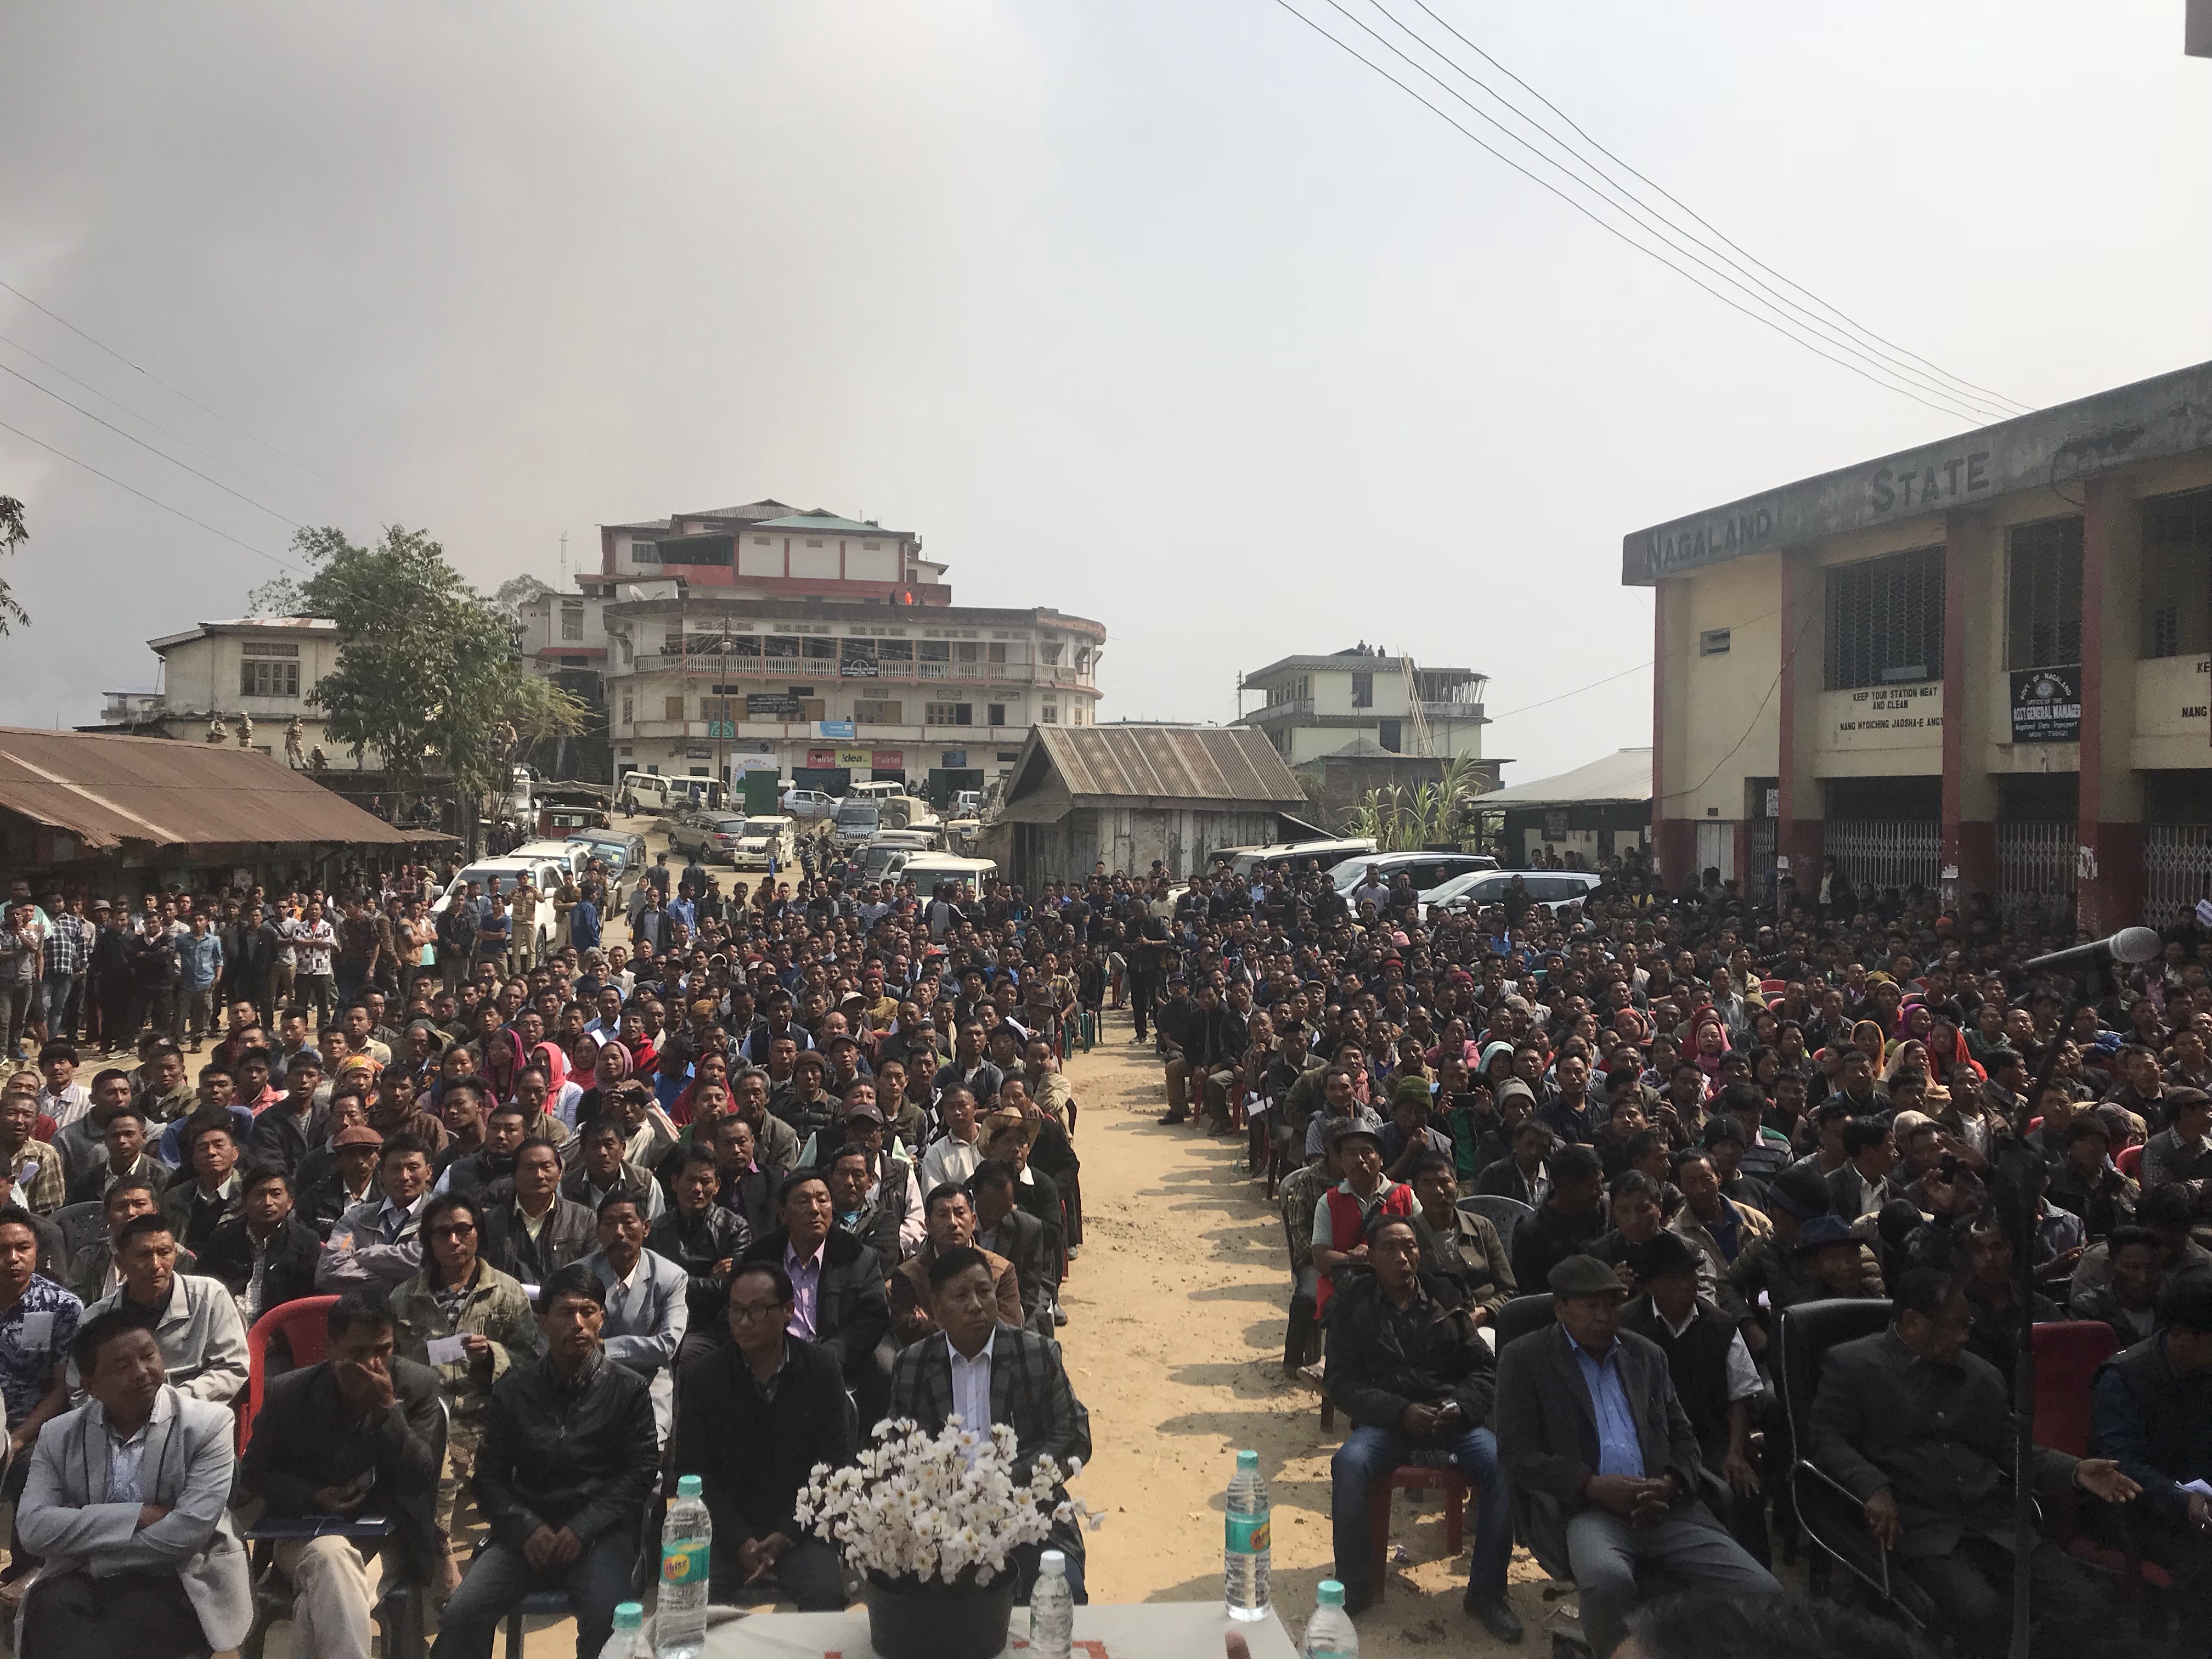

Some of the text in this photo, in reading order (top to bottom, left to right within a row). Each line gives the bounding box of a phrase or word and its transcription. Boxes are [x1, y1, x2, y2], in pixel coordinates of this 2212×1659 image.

[1646, 450, 1990, 569] NAGALAND STATE
[2197, 662, 2210, 673] KE
[2033, 674, 2040, 682] OF
[2045, 673, 2072, 696] NAGALAND
[1853, 692, 1869, 702] KEEP
[1872, 690, 1887, 700] YOUR
[1890, 689, 1917, 699] STATION
[1872, 699, 1908, 710] AND CLEAN
[2182, 706, 2207, 718] NANG
[1840, 721, 1855, 731] NANG
